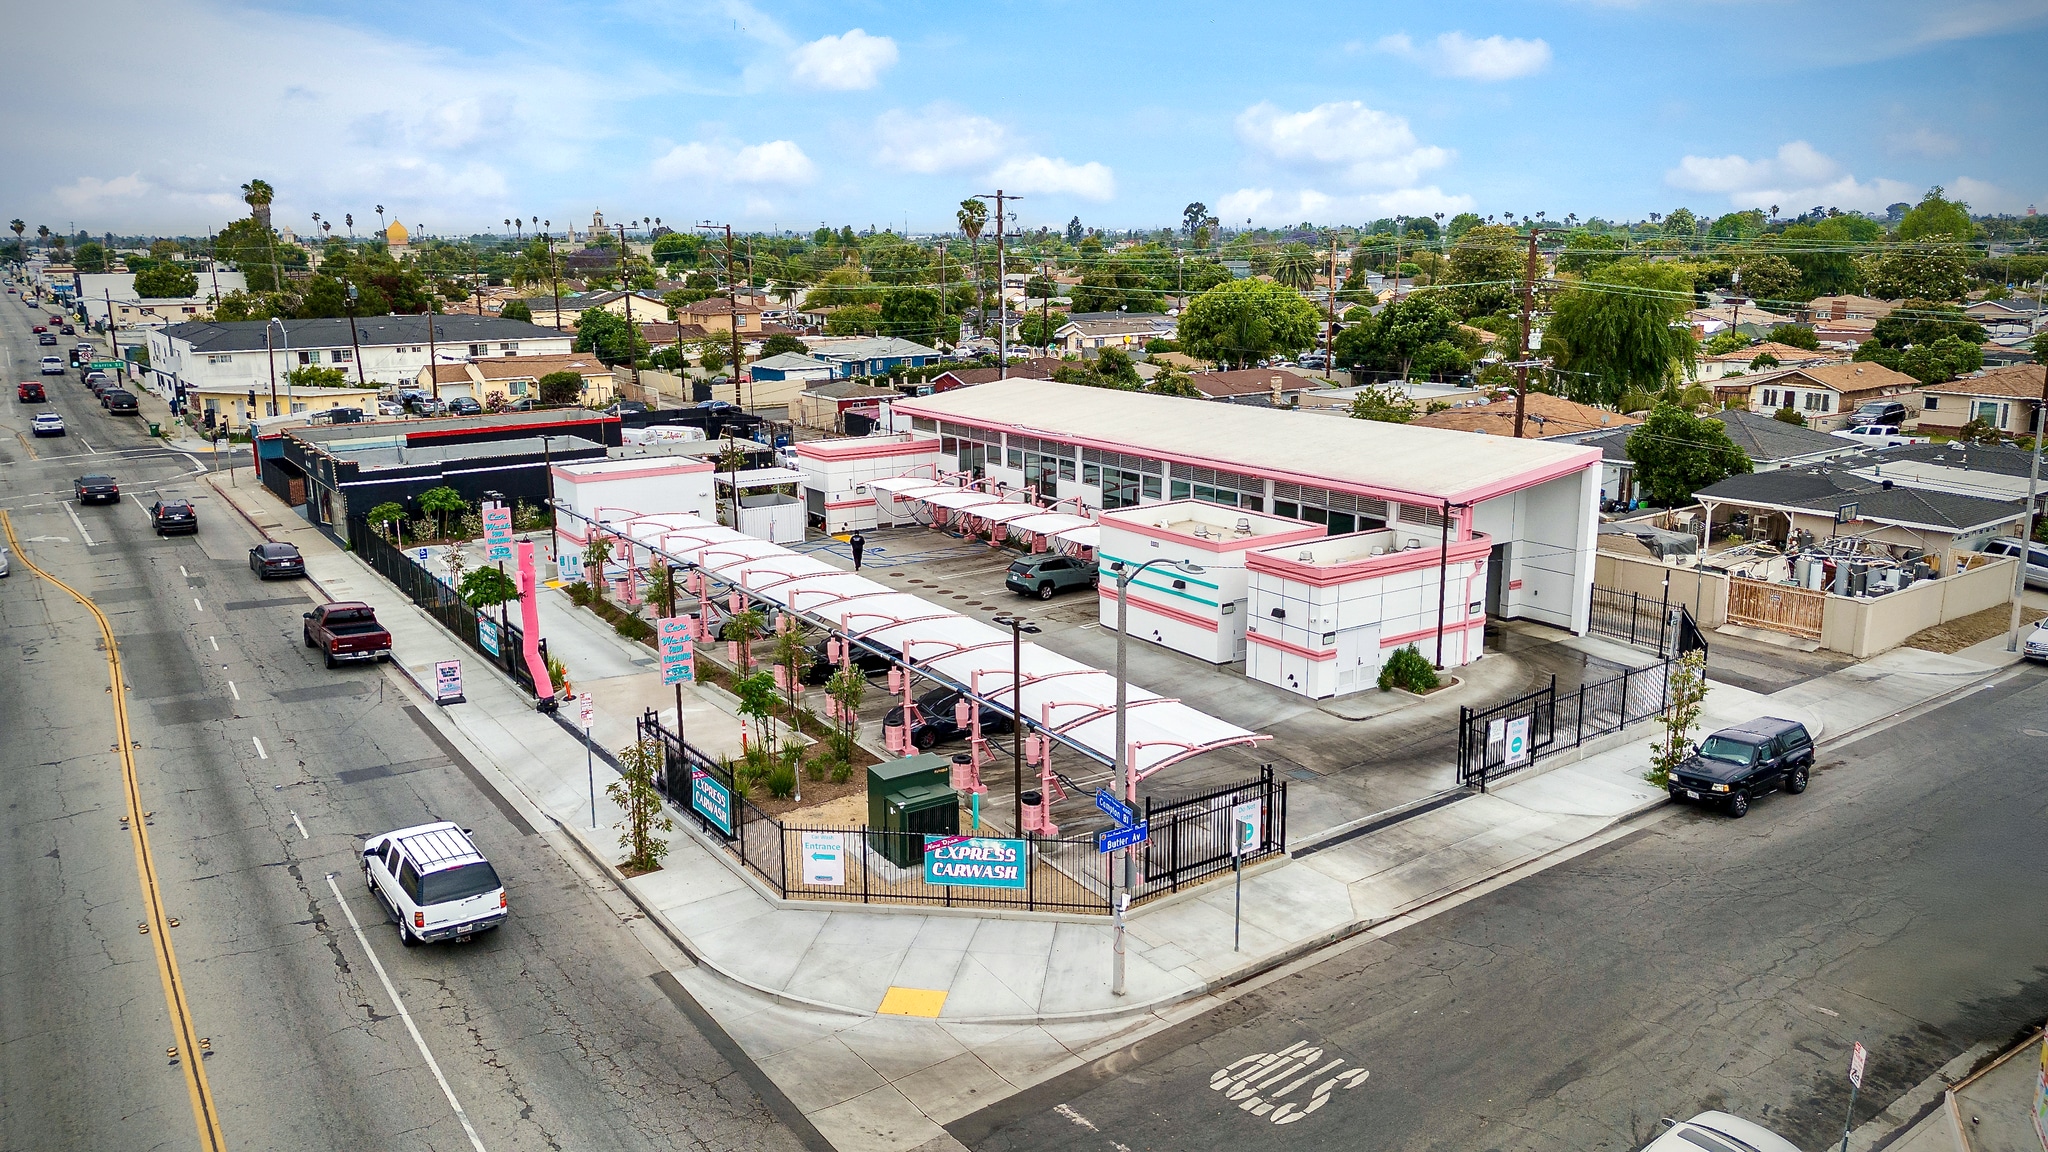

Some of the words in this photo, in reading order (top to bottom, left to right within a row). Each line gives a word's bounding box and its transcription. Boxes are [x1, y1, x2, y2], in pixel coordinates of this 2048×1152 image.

[664, 622, 688, 633] Car
[661, 634, 692, 646] Wash
[695, 778, 726, 808] EXPRESS
[695, 791, 727, 825] CARWASH
[1099, 797, 1121, 819] Compton
[805, 842, 841, 850] Entrance
[1107, 837, 1129, 850] Butler
[1132, 832, 1141, 843] Av
[934, 846, 1016, 863] EXPRESS
[932, 862, 1018, 880] CARWASH
[1209, 1039, 1371, 1126] STOP
